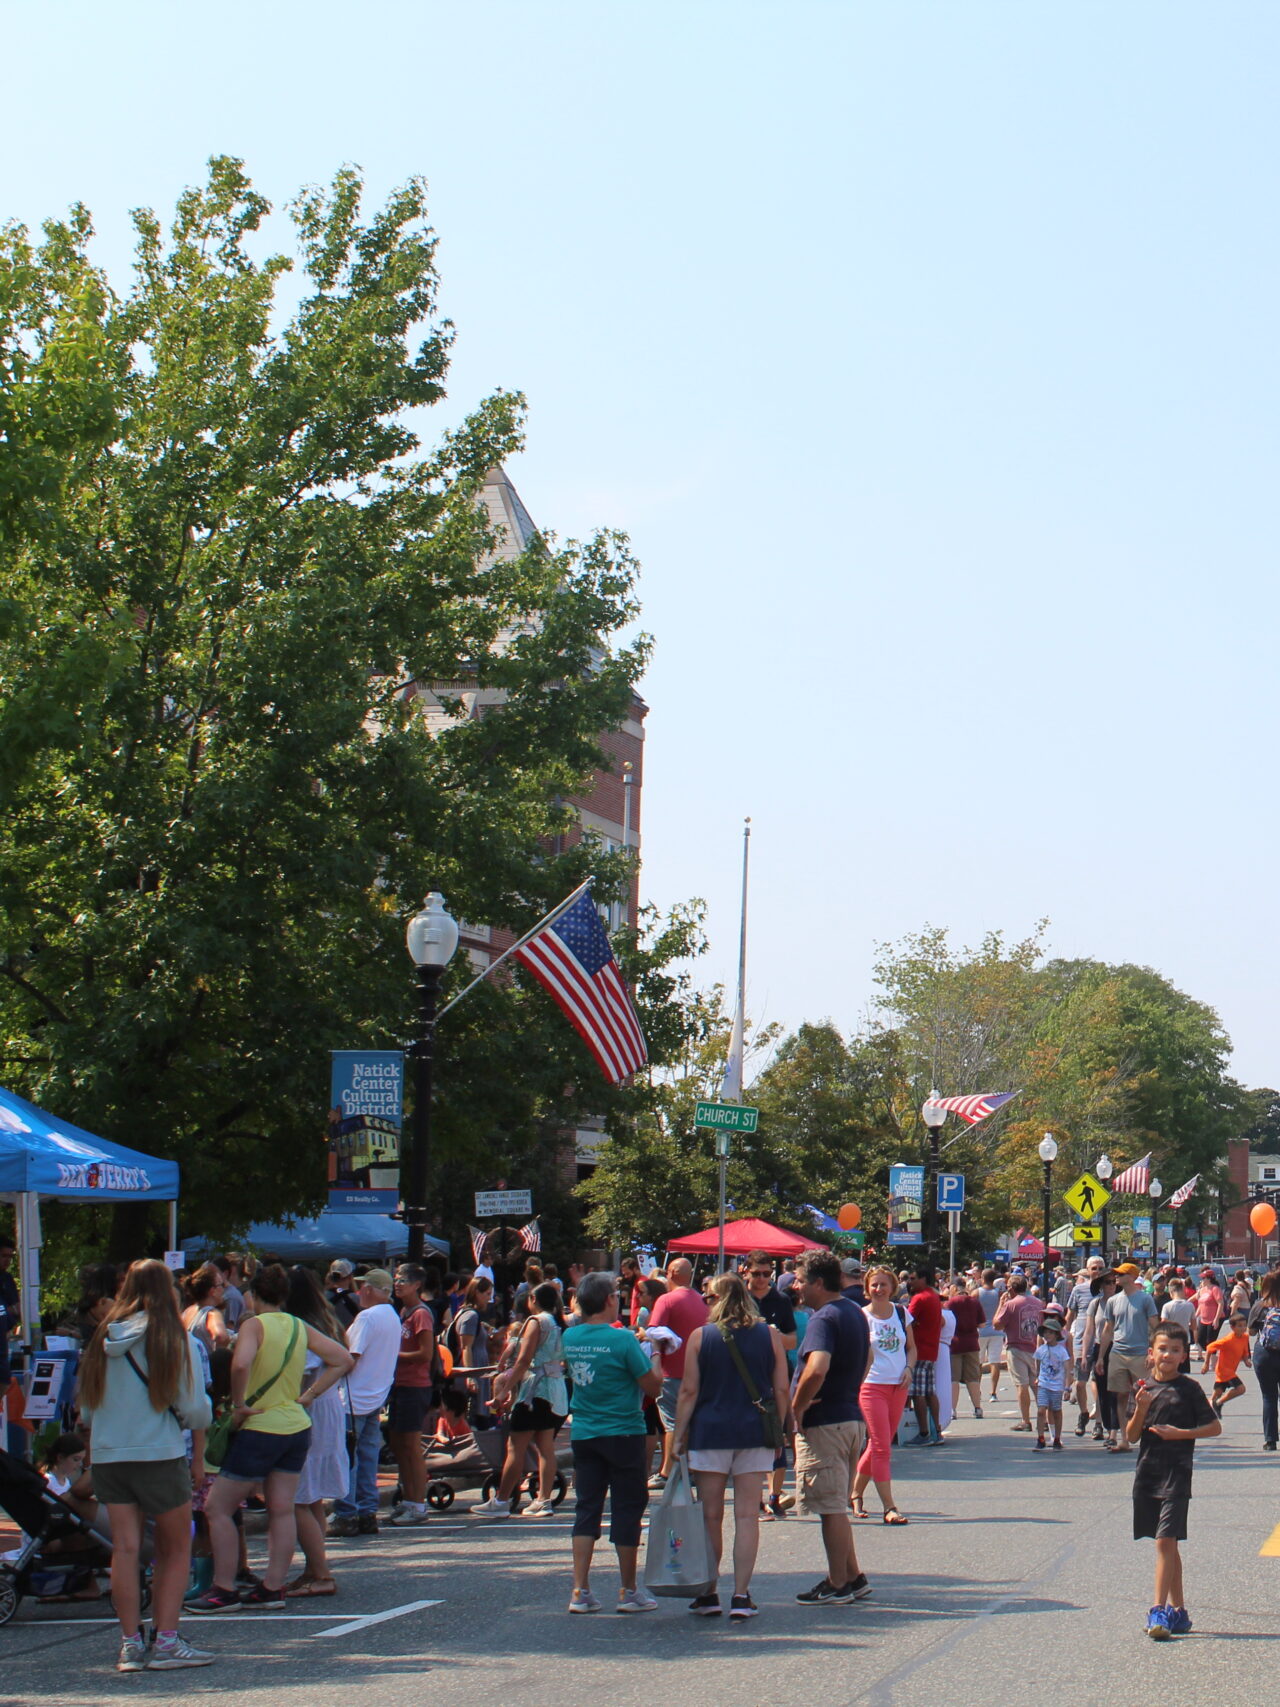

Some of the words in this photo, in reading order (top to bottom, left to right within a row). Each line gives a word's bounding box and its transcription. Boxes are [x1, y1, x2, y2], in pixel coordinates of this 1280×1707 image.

[353, 1064, 400, 1077] Natick
[352, 1077, 400, 1090] Center
[342, 1089, 399, 1102] Cultural
[345, 1103, 399, 1115] District
[697, 1107, 739, 1125] CHURCH
[742, 1112, 756, 1127] ST
[57, 1162, 88, 1188] BEN
[98, 1163, 151, 1191] JERRY'S
[943, 1176, 959, 1200] P
